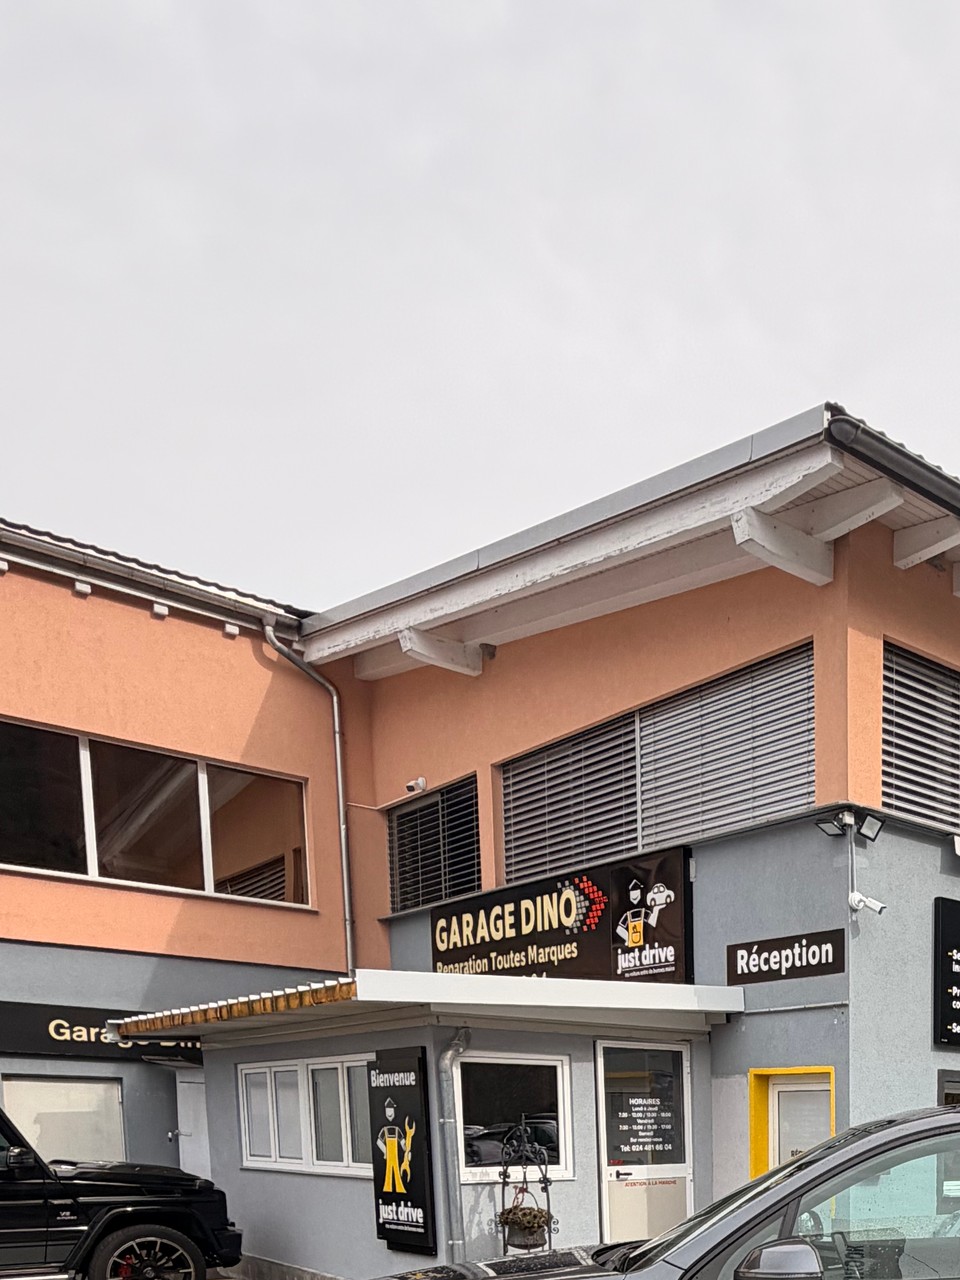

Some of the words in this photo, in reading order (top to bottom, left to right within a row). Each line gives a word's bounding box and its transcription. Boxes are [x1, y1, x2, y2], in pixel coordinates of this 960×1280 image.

[436, 900, 516, 951] GARAGE
[521, 889, 577, 936] DINO
[490, 950, 526, 971] Toutes
[528, 942, 578, 966] Marques
[617, 948, 640, 974] just
[642, 942, 675, 965] drive
[737, 939, 833, 975] Réception
[371, 1070, 416, 1087] Bienvenue
[379, 1199, 398, 1223] just
[399, 1201, 423, 1223] drive
